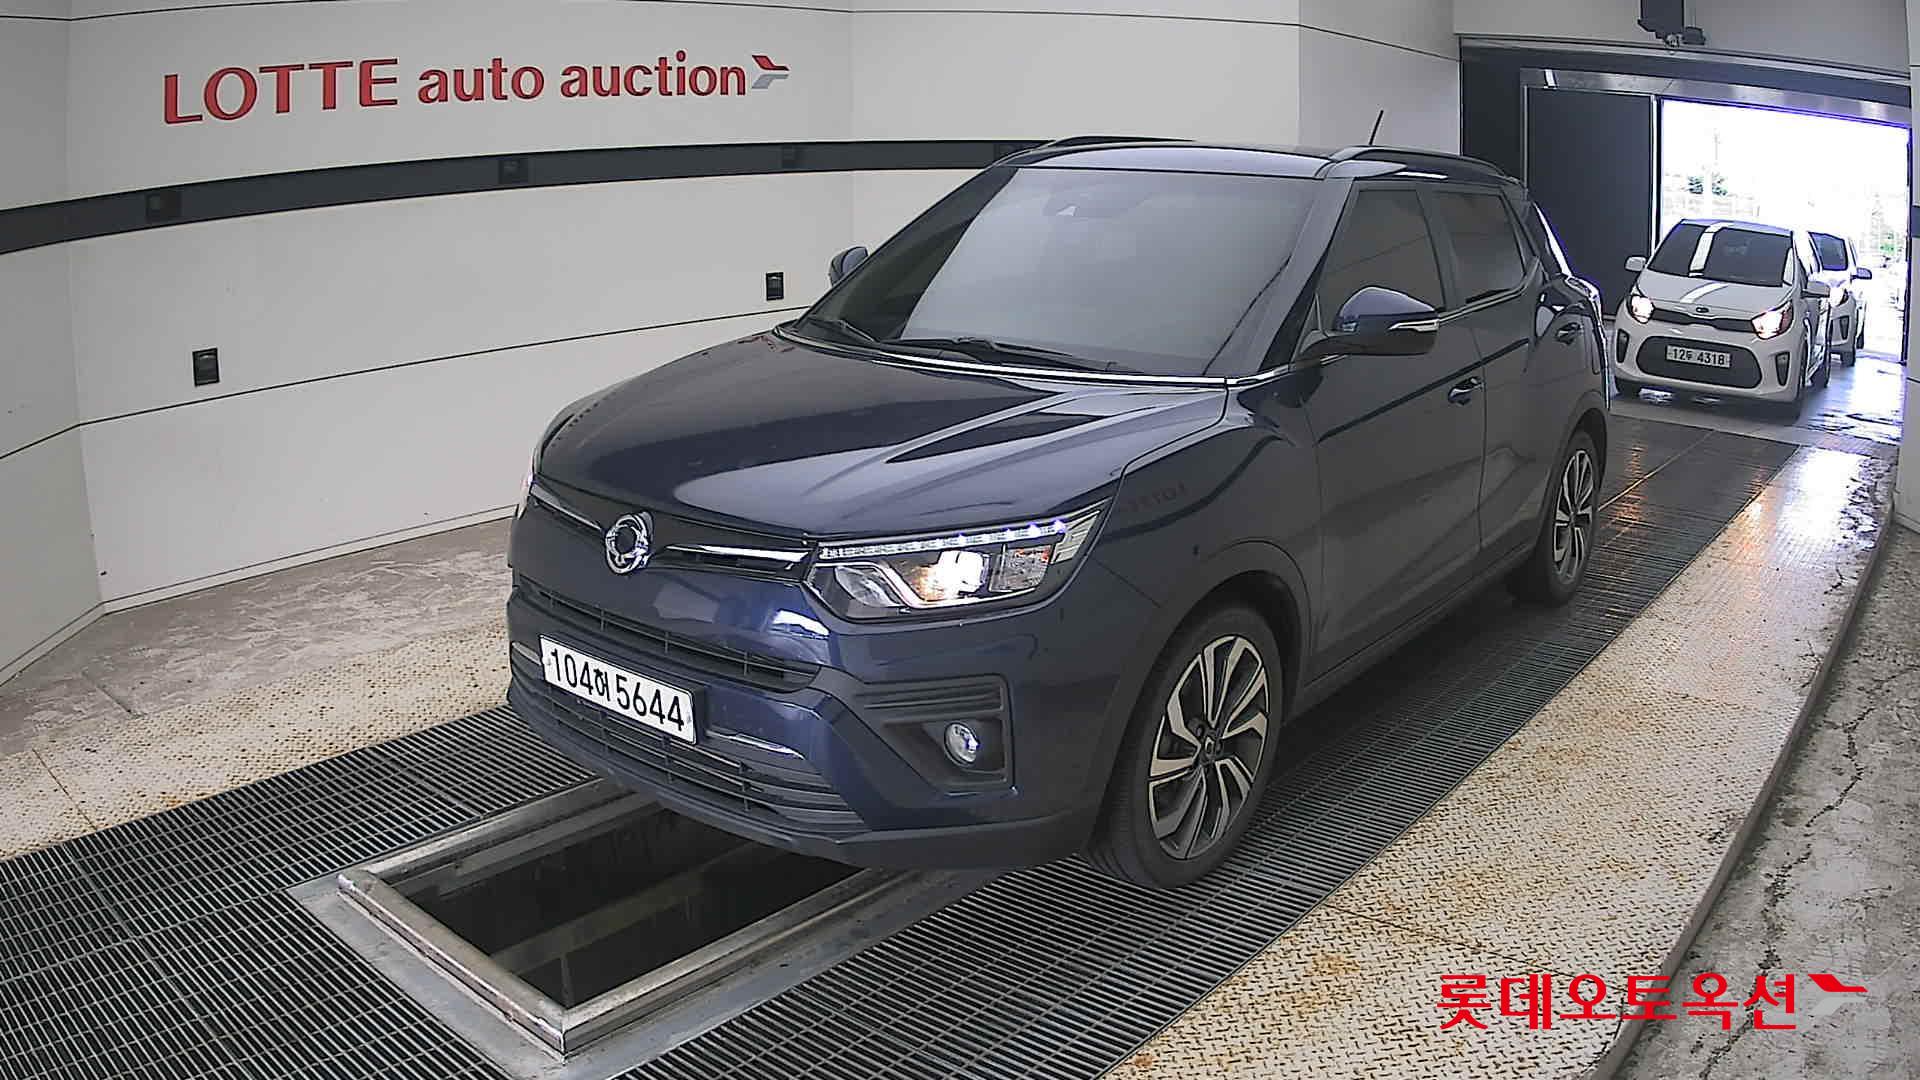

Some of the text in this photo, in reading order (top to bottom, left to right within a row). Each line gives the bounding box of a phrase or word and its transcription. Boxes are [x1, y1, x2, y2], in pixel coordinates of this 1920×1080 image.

[164, 50, 748, 125] LOTTE auto auction
[1696, 351, 1725, 366] 4318
[615, 673, 685, 732] 5644
